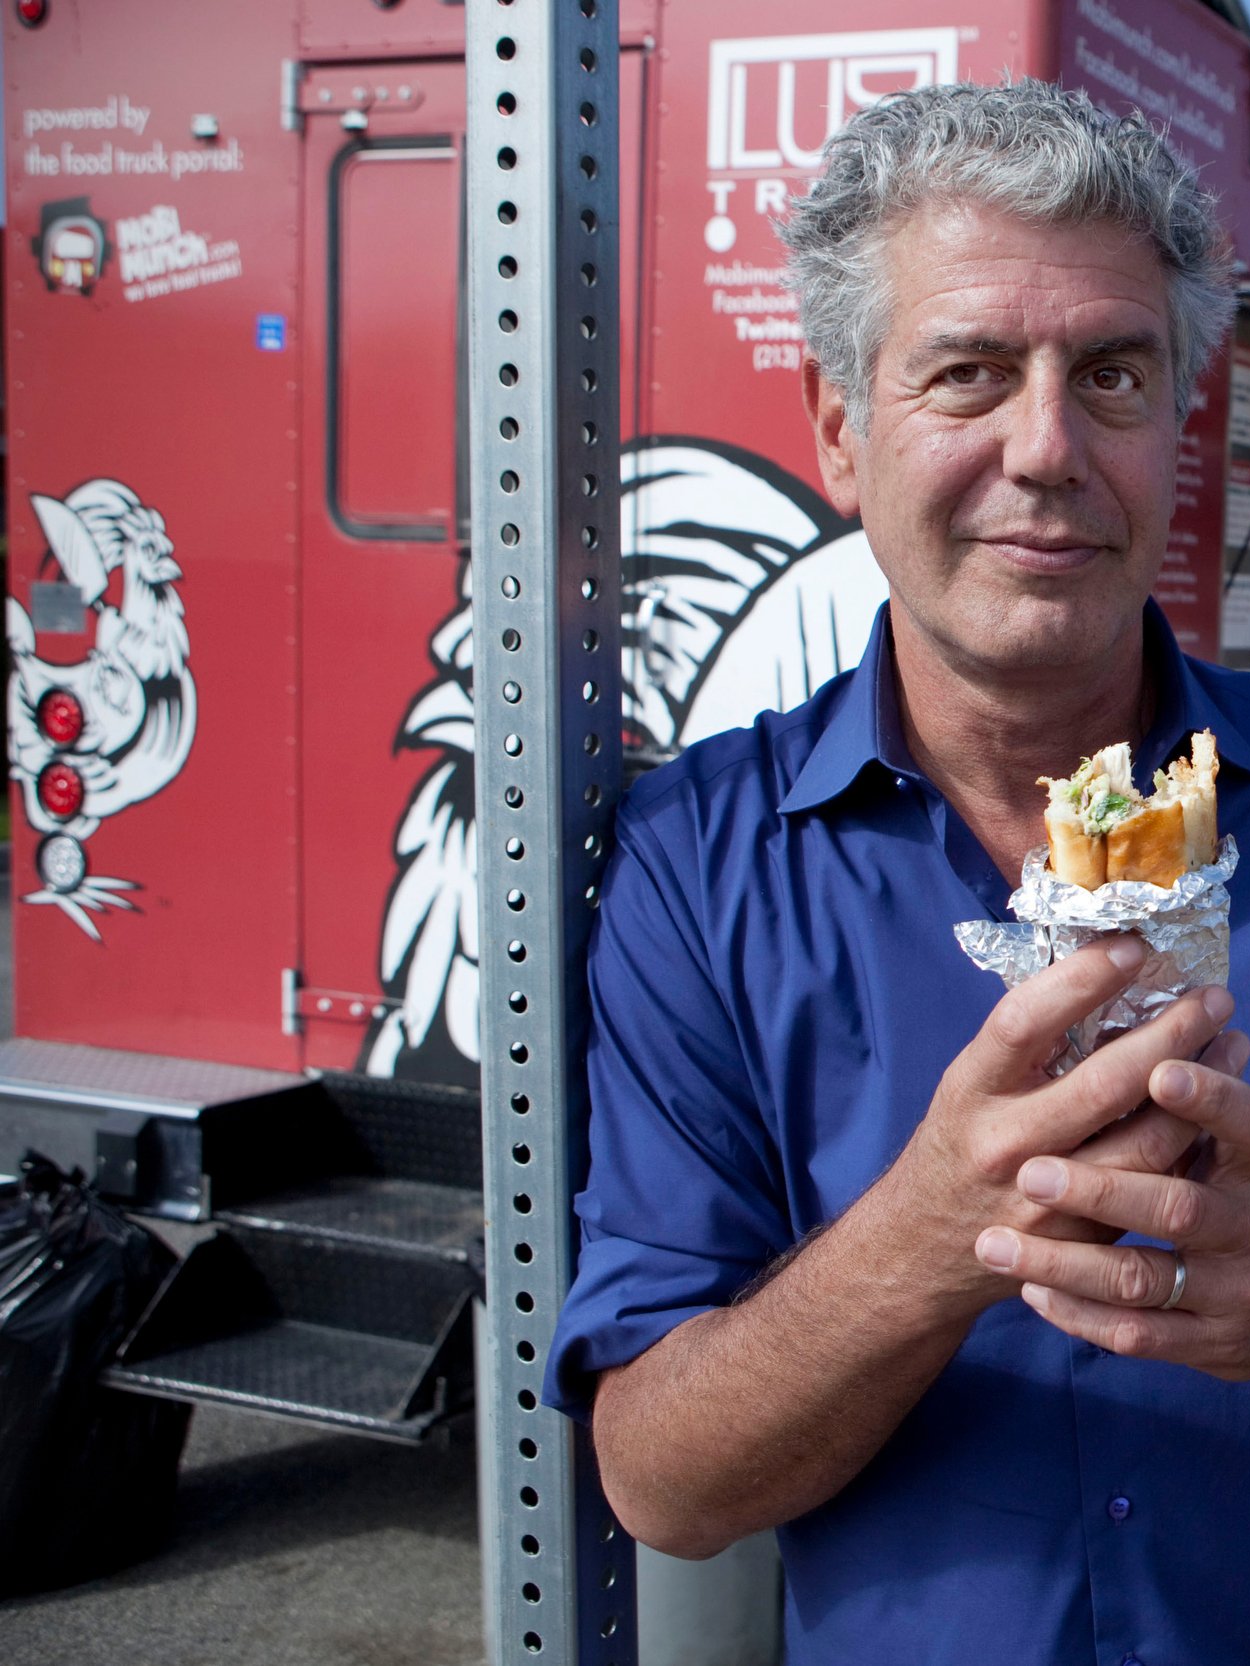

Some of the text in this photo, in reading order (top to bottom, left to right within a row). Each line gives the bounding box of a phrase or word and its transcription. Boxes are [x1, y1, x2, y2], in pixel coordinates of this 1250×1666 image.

[24, 94, 150, 138] powered by
[25, 142, 59, 175] the
[61, 142, 112, 175] food
[115, 138, 168, 173] truck
